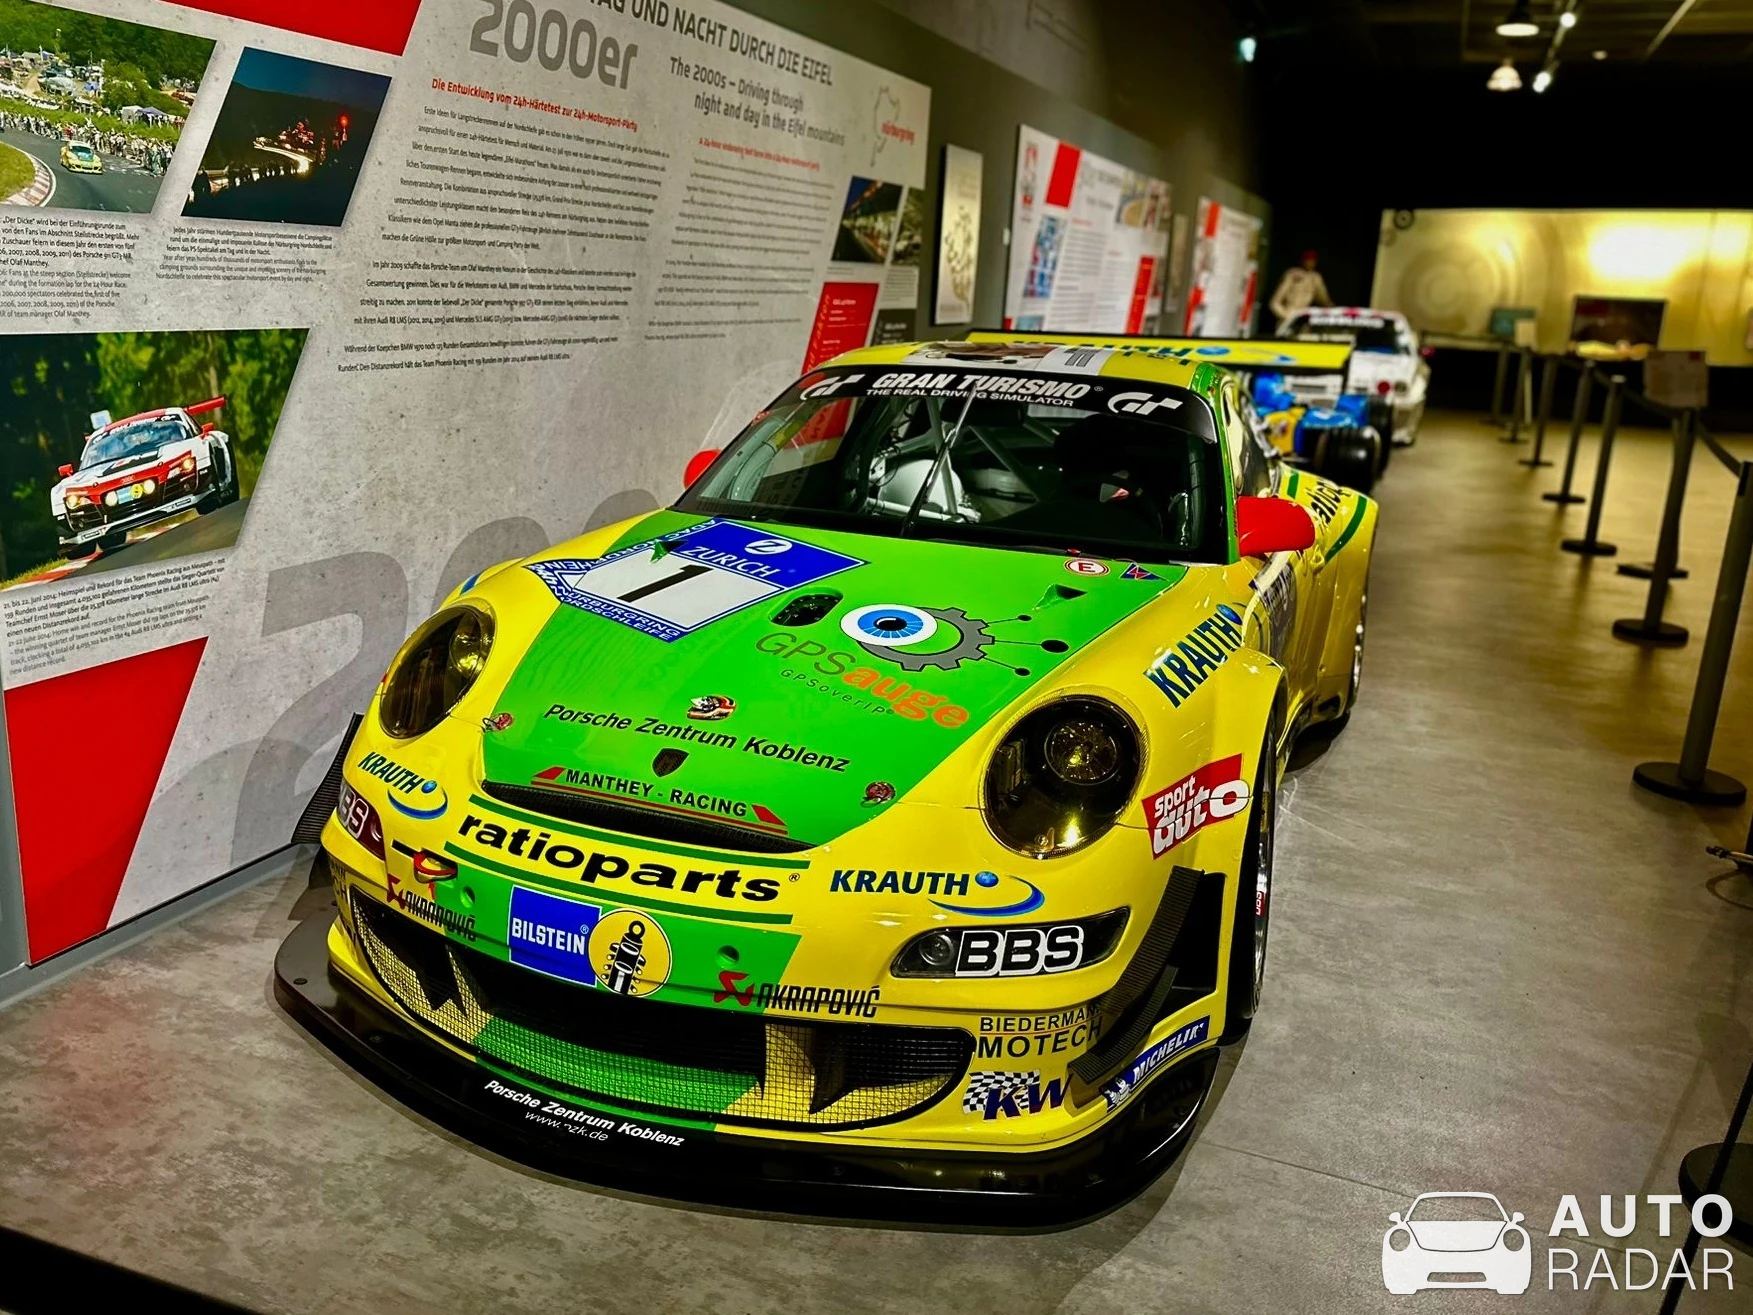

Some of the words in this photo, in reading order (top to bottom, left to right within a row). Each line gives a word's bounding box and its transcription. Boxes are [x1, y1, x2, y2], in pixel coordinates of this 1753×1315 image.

[470, 0, 639, 90] 2000er
[631, 0, 669, 27] UND
[673, 7, 727, 48] NACHT
[729, 28, 775, 67] DURCH
[777, 47, 800, 72] DIE
[802, 54, 834, 86] EIFEL
[432, 78, 446, 91] Die
[447, 81, 494, 103] Entwicklung
[496, 93, 512, 105] vom
[513, 95, 561, 115] 24h-Härtetest
[562, 106, 573, 117] zur
[573, 109, 638, 132] 24h-Motorsport-Party
[670, 57, 691, 78] The
[694, 62, 727, 89] 2000s
[738, 78, 771, 107] Driving
[772, 88, 804, 113] through
[694, 93, 722, 118] night
[723, 99, 741, 119] and
[743, 103, 761, 128] day
[761, 107, 771, 126] in
[771, 109, 787, 132] the
[788, 115, 807, 139] Eifel
[2, 237, 31, 245] Zuschauer
[32, 238, 48, 246] feiern
[871, 373, 957, 389] GRAN
[956, 374, 1091, 399] TURISMO
[893, 389, 928, 397] REAL
[930, 389, 988, 399] DRIVIG
[989, 392, 1074, 407] SIMULATOR
[617, 563, 714, 604] 1
[681, 546, 781, 579] ZURICH
[15, 606, 36, 615] Runden
[58, 588, 84, 597] Heimspiel
[97, 580, 114, 589] Rekord
[1143, 613, 1243, 709] KRAUTH
[543, 704, 632, 730] Porsche
[635, 717, 738, 749] Zentrum
[743, 737, 851, 773] Koblenz
[357, 752, 425, 794] KRAUTH
[566, 769, 652, 799] MANTHEY
[669, 787, 748, 818] RACING
[1153, 780, 1250, 855] auto
[1154, 775, 1196, 819] sport
[457, 813, 781, 902] ratioparts
[829, 869, 970, 896] KRAUTH
[511, 917, 586, 956] BILSTEIN
[955, 925, 1085, 978] BBS
[977, 1015, 1102, 1058] MOTECH
[979, 1001, 1099, 1032] BIEDERMAN
[484, 1080, 541, 1108] Porsche
[541, 1101, 616, 1130] Zentrum
[617, 1122, 685, 1146] Koblenz
[982, 1073, 1074, 1120] KW
